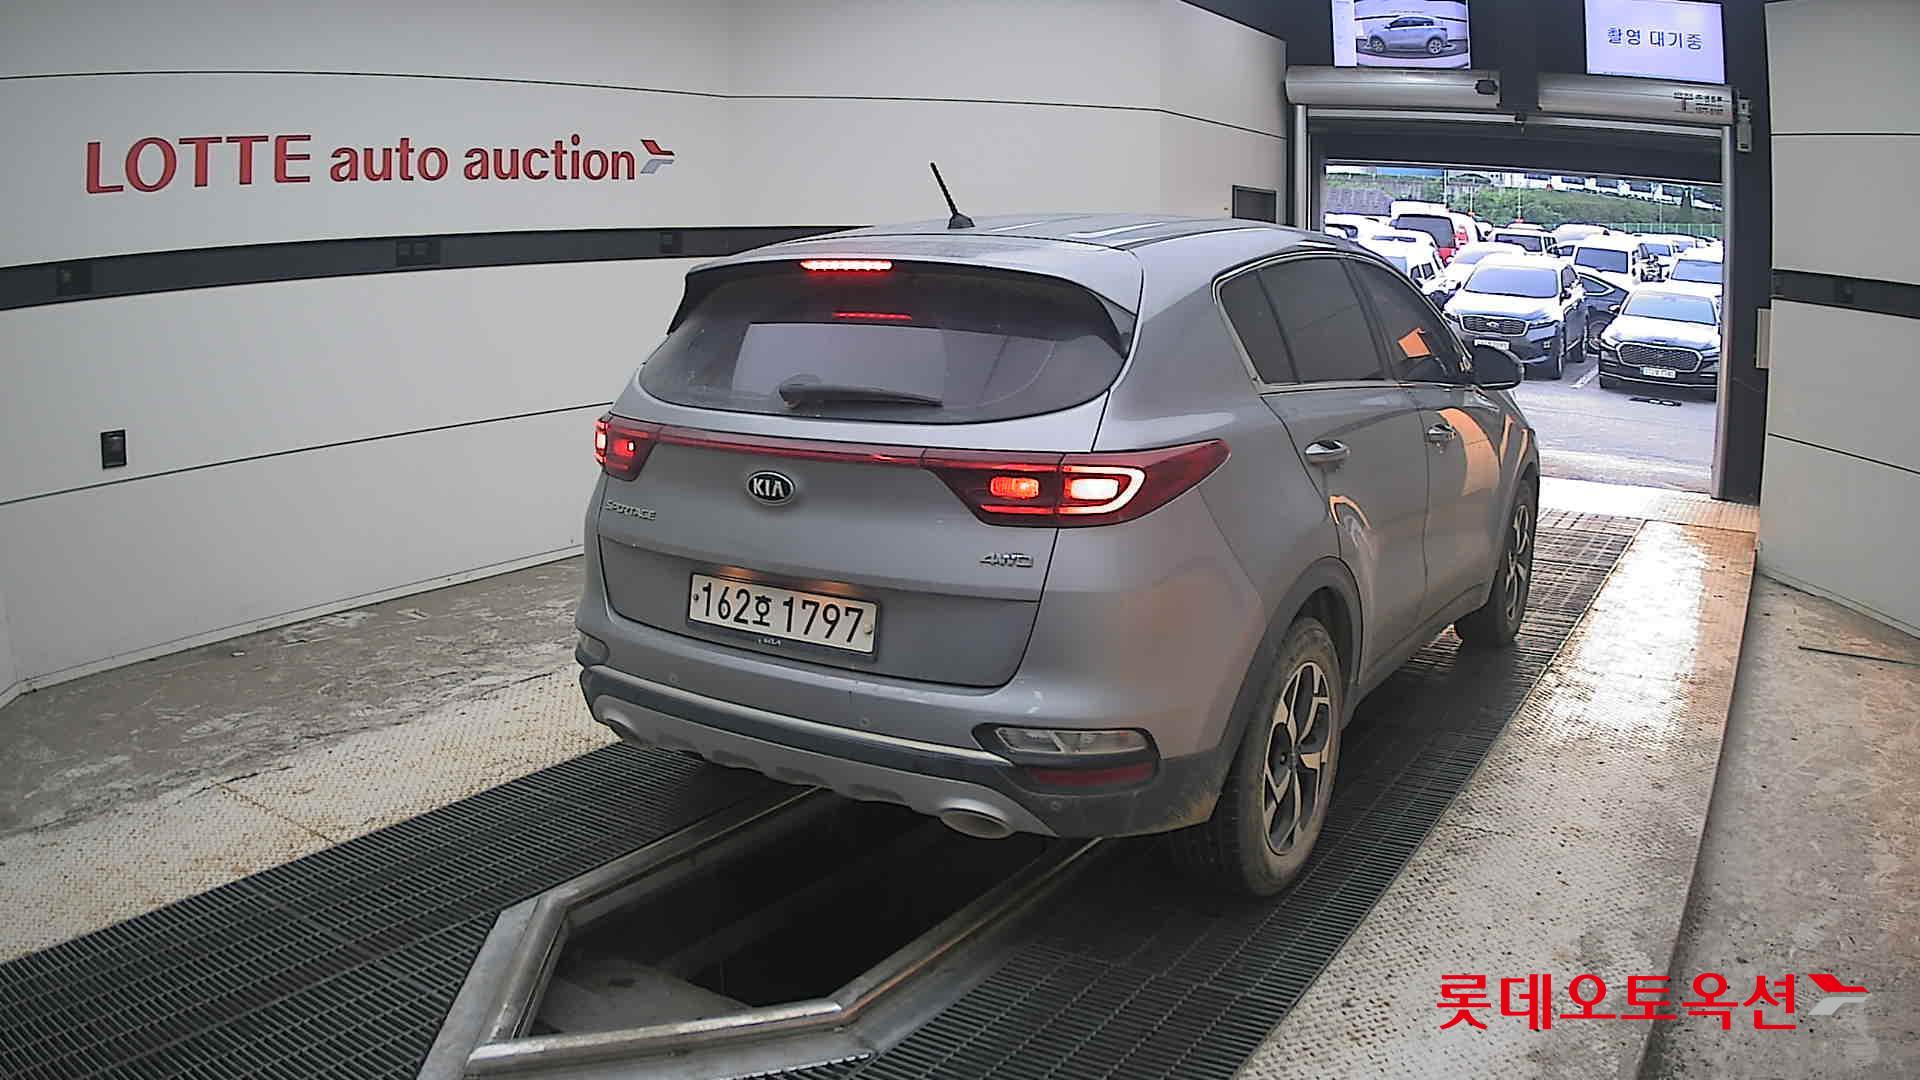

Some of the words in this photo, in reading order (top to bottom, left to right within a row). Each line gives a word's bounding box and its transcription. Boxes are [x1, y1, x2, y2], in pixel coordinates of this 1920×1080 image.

[1650, 30, 1702, 51] 대기중
[86, 134, 312, 194] LOTTE
[329, 137, 449, 182] auto
[463, 134, 636, 182] auction
[752, 477, 786, 498] KIA
[606, 499, 657, 521] SPORTAGE
[980, 553, 1033, 568] 4WD
[702, 581, 772, 628] 162호
[782, 596, 864, 643] 1797
